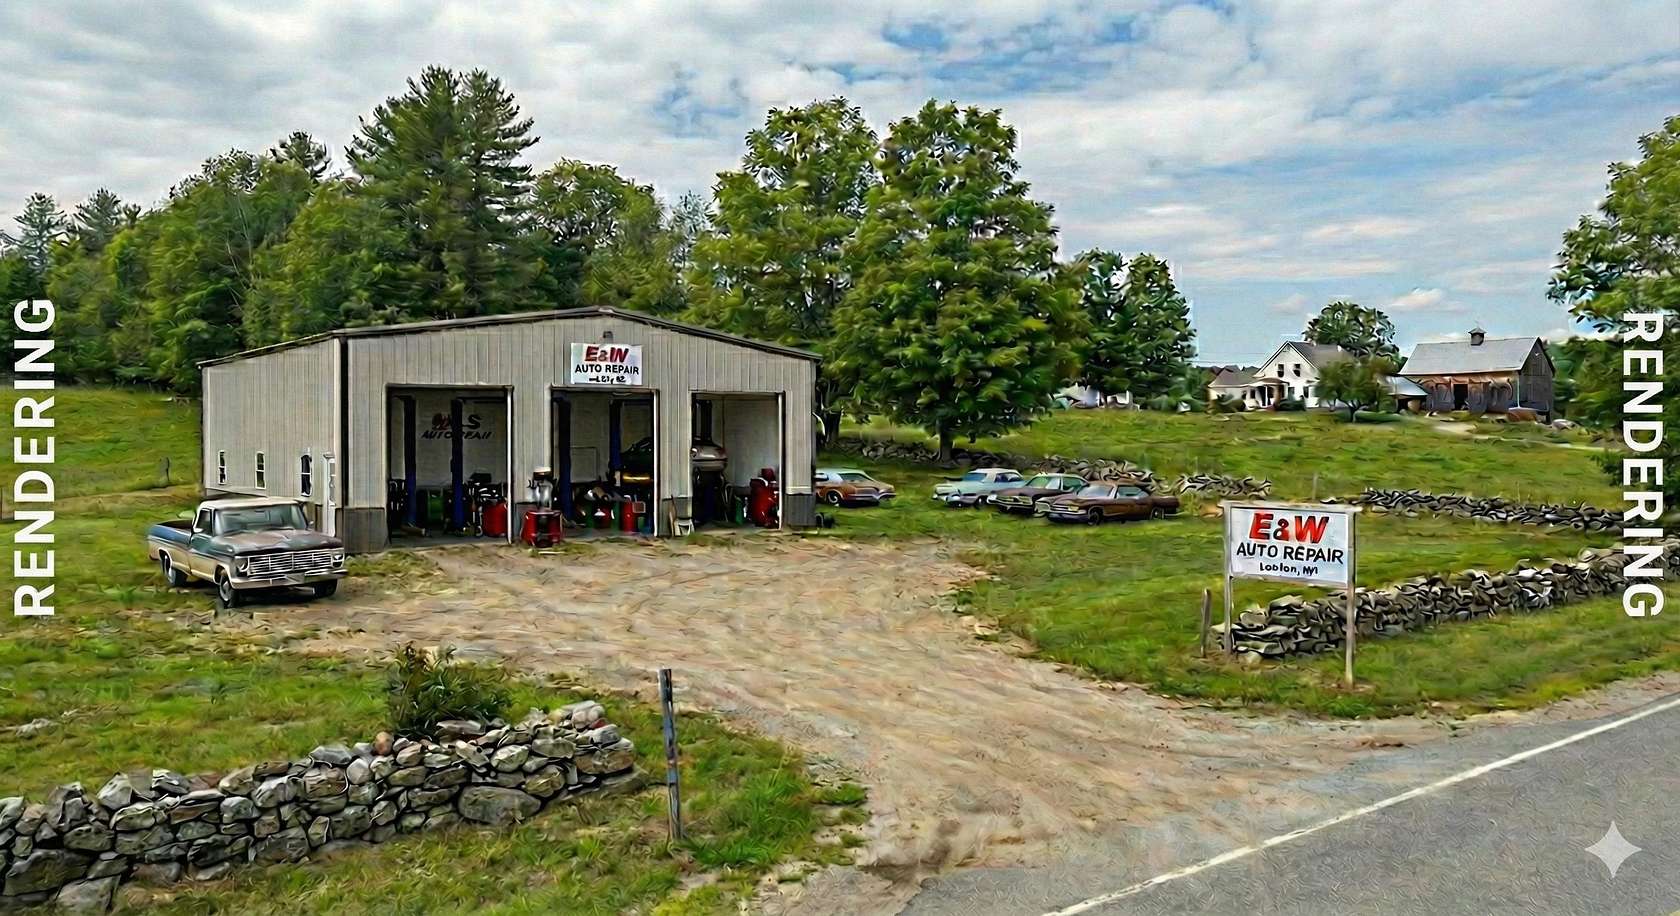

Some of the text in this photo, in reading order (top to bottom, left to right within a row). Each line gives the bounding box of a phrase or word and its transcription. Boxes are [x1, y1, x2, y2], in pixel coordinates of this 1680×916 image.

[585, 346, 629, 363] E&W
[575, 364, 639, 375] AUTO REPAIR
[1249, 512, 1330, 544] E&W
[1237, 542, 1344, 565] AUTO REPAIR
